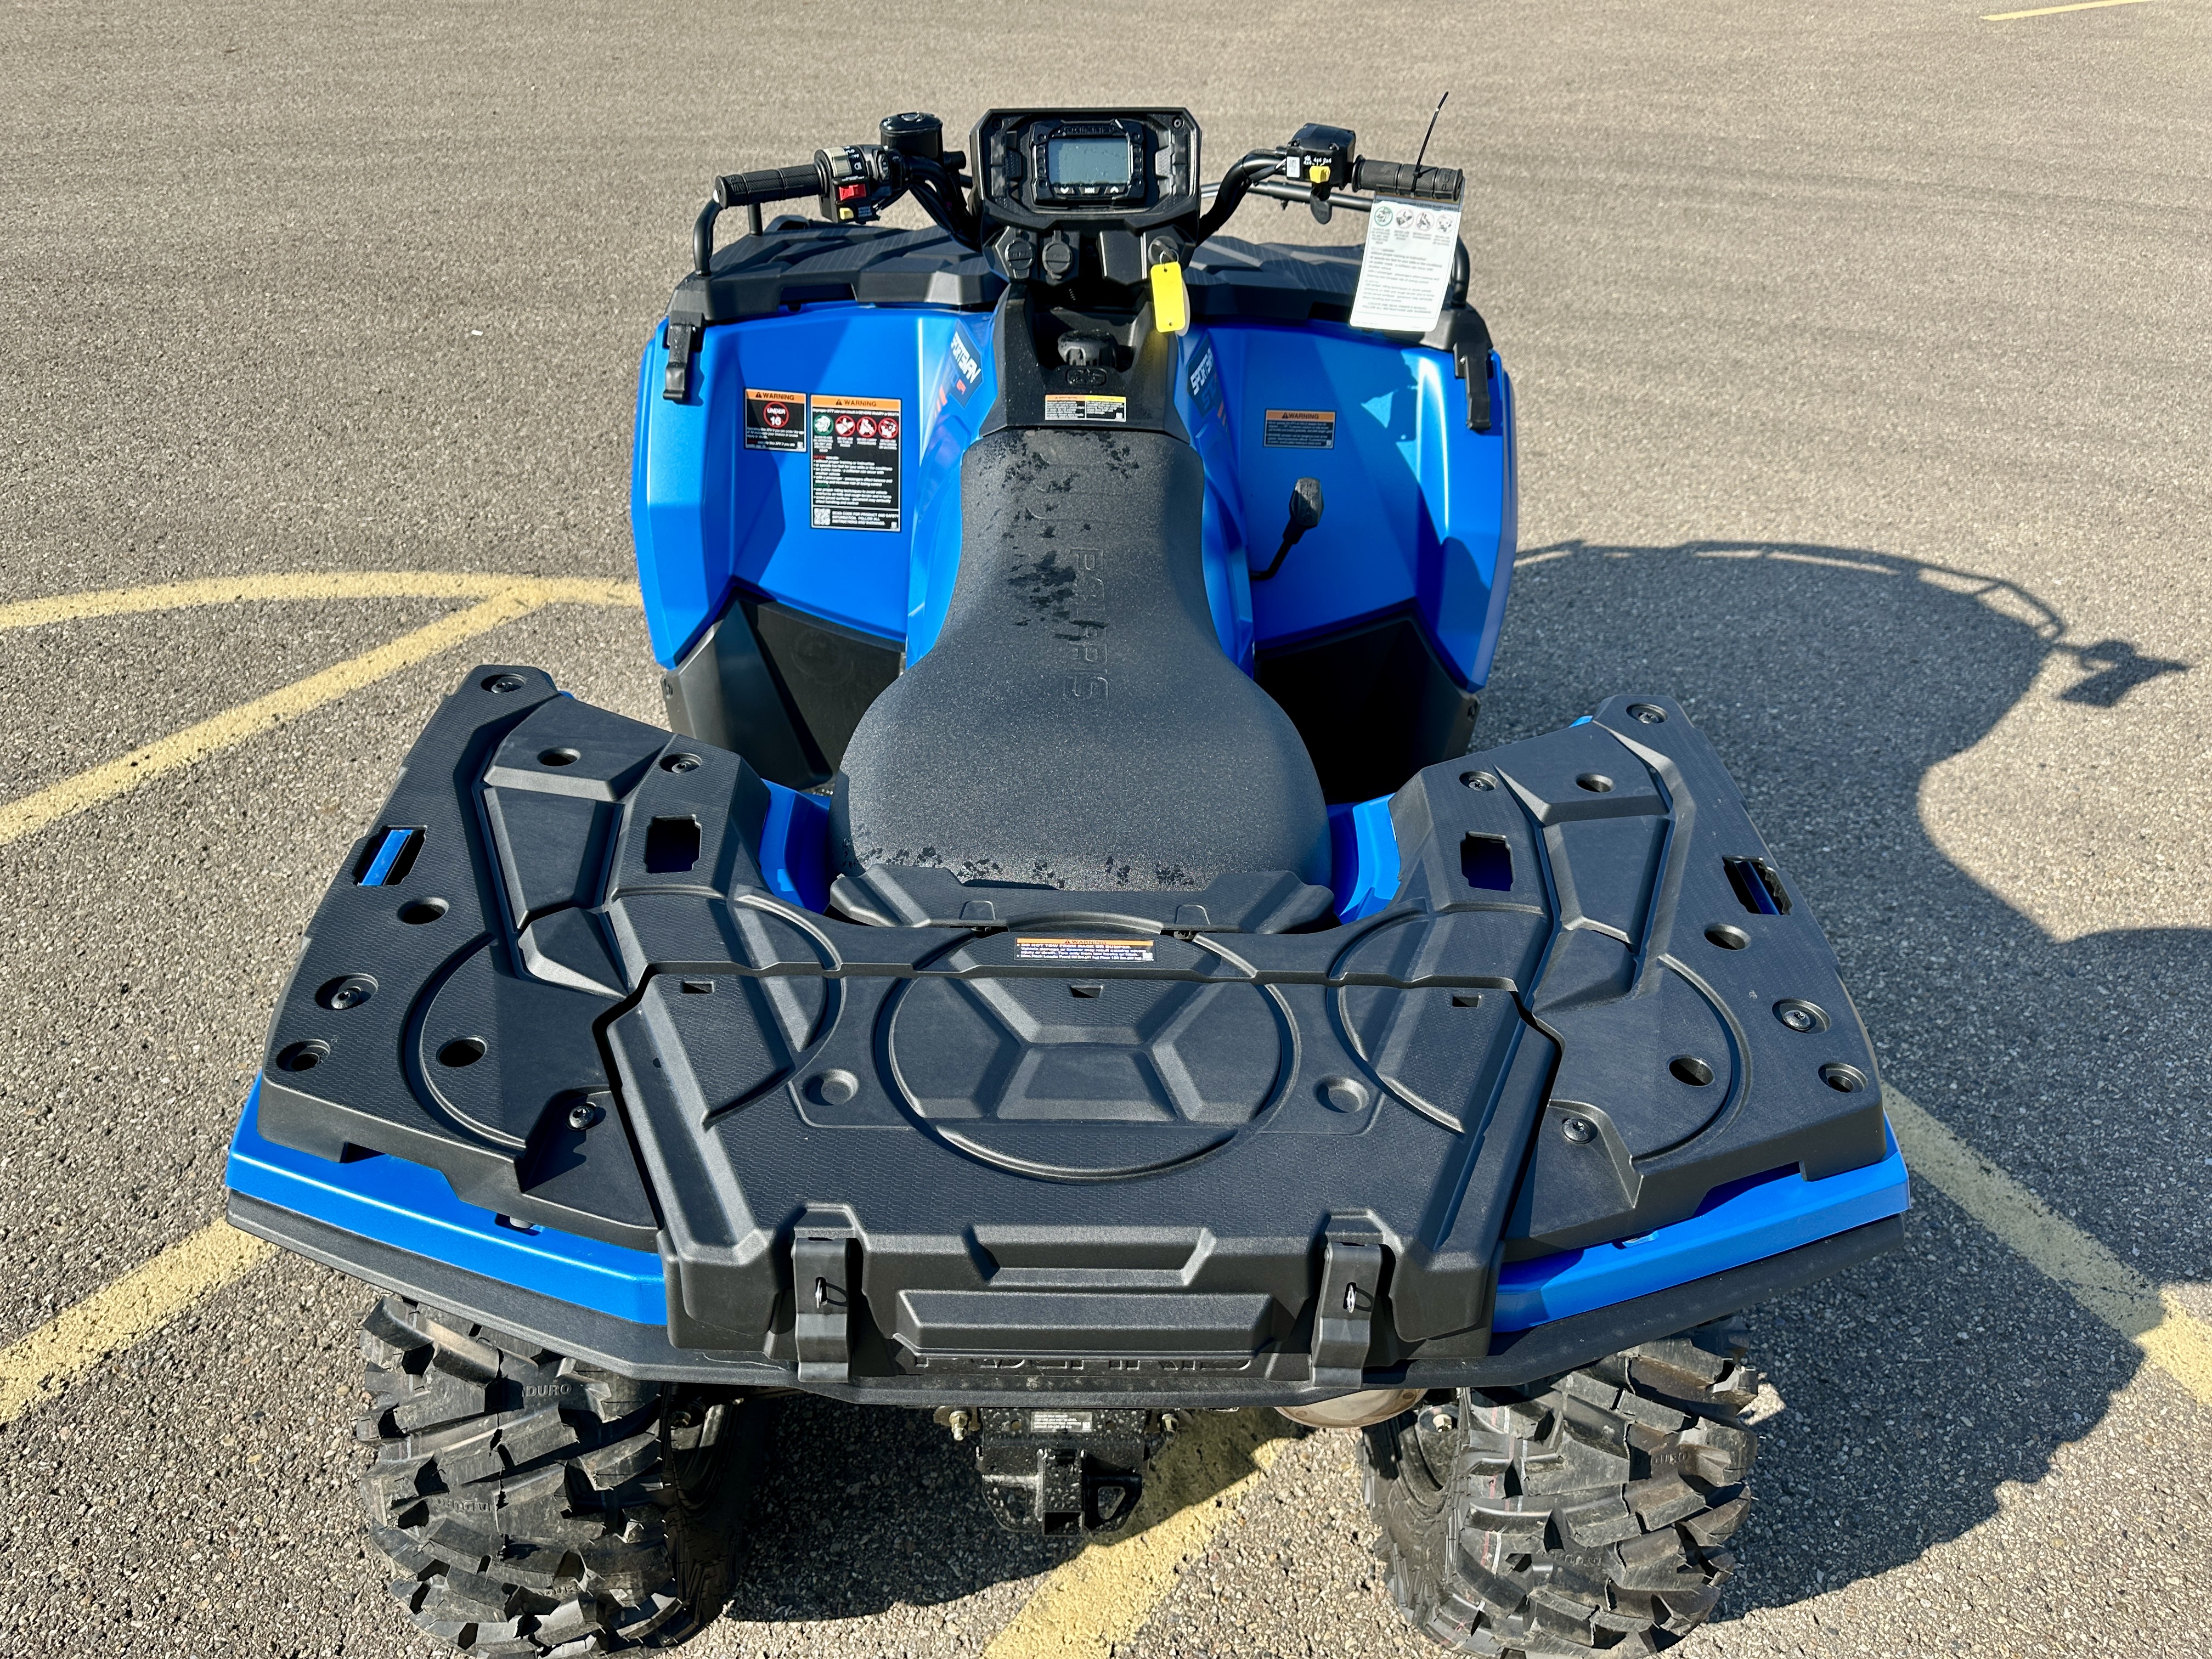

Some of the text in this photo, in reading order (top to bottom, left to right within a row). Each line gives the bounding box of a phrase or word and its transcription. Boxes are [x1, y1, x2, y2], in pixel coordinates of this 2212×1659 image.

[763, 392, 794, 400] WARNING
[770, 416, 782, 426] 16
[526, 1384, 572, 1397] DURO
[1650, 1452, 1688, 1465] DURO
